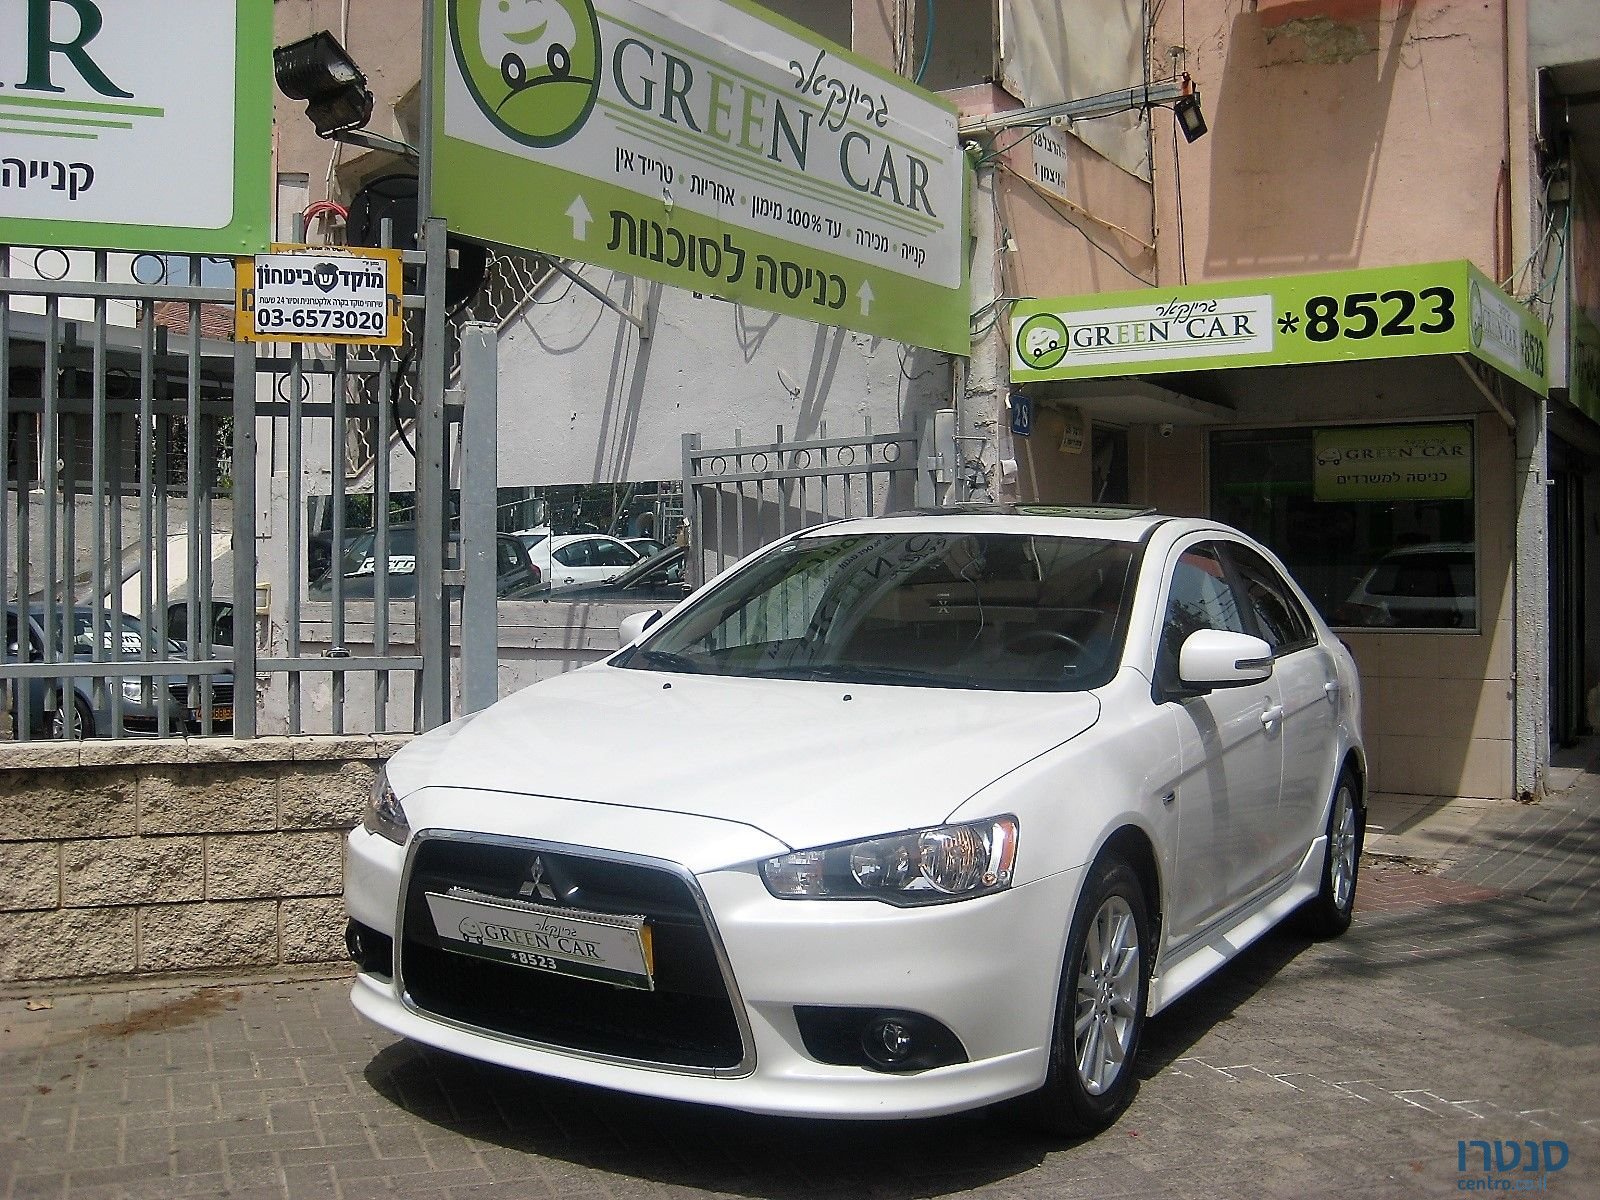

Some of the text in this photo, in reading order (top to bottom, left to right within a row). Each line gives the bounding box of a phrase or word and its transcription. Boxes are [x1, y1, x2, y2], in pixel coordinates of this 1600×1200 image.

[612, 38, 937, 217] GREEN CAR
[1, 157, 95, 200] קנייה
[615, 147, 926, 269] קנייה מכירה עד 100% מימון אחריות טרייד אין
[606, 210, 848, 310] כניסה לסוכנות
[276, 296, 285, 304] 24
[257, 308, 384, 330] 03-6573020
[1074, 321, 1170, 348] GREEN
[1186, 315, 1255, 339] CAR
[1013, 403, 1028, 428] 28
[1423, 445, 1464, 457] CAR
[1336, 471, 1448, 485] כניסה למשרדים
[484, 925, 601, 959] GREEN CAR
